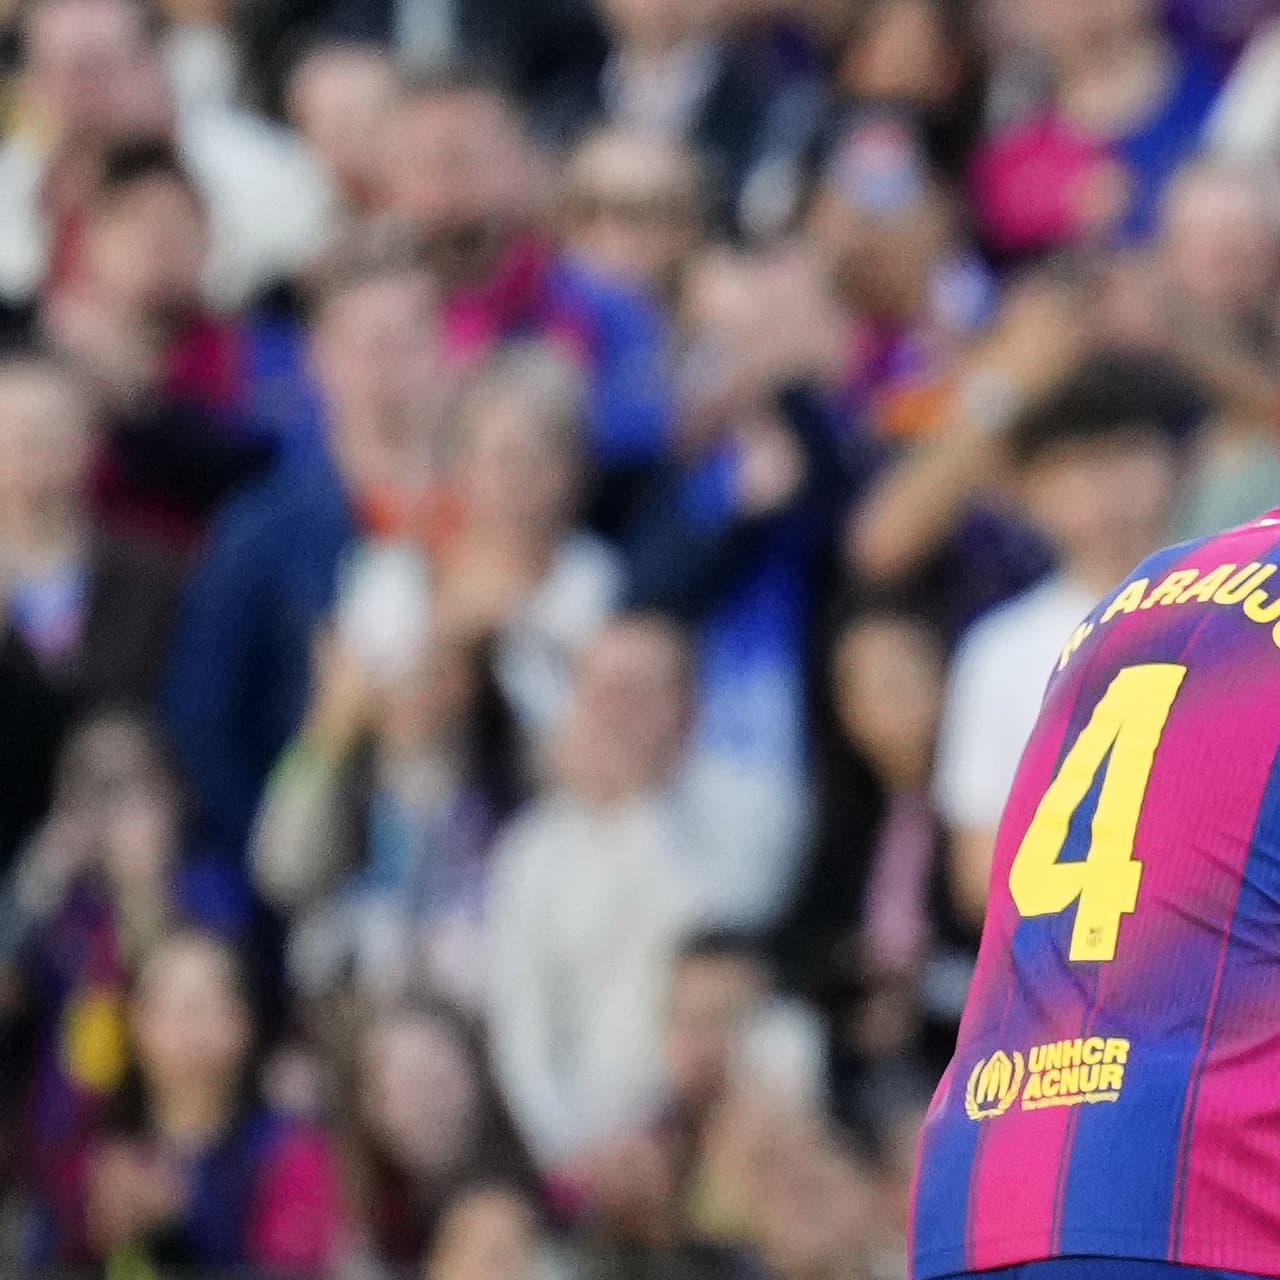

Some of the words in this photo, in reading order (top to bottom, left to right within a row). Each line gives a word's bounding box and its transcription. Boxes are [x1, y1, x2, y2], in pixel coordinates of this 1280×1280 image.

[1007, 663, 1187, 961] 4
[1028, 1036, 1130, 1073] UNHCR
[1022, 1064, 1124, 1098] ACNUR
